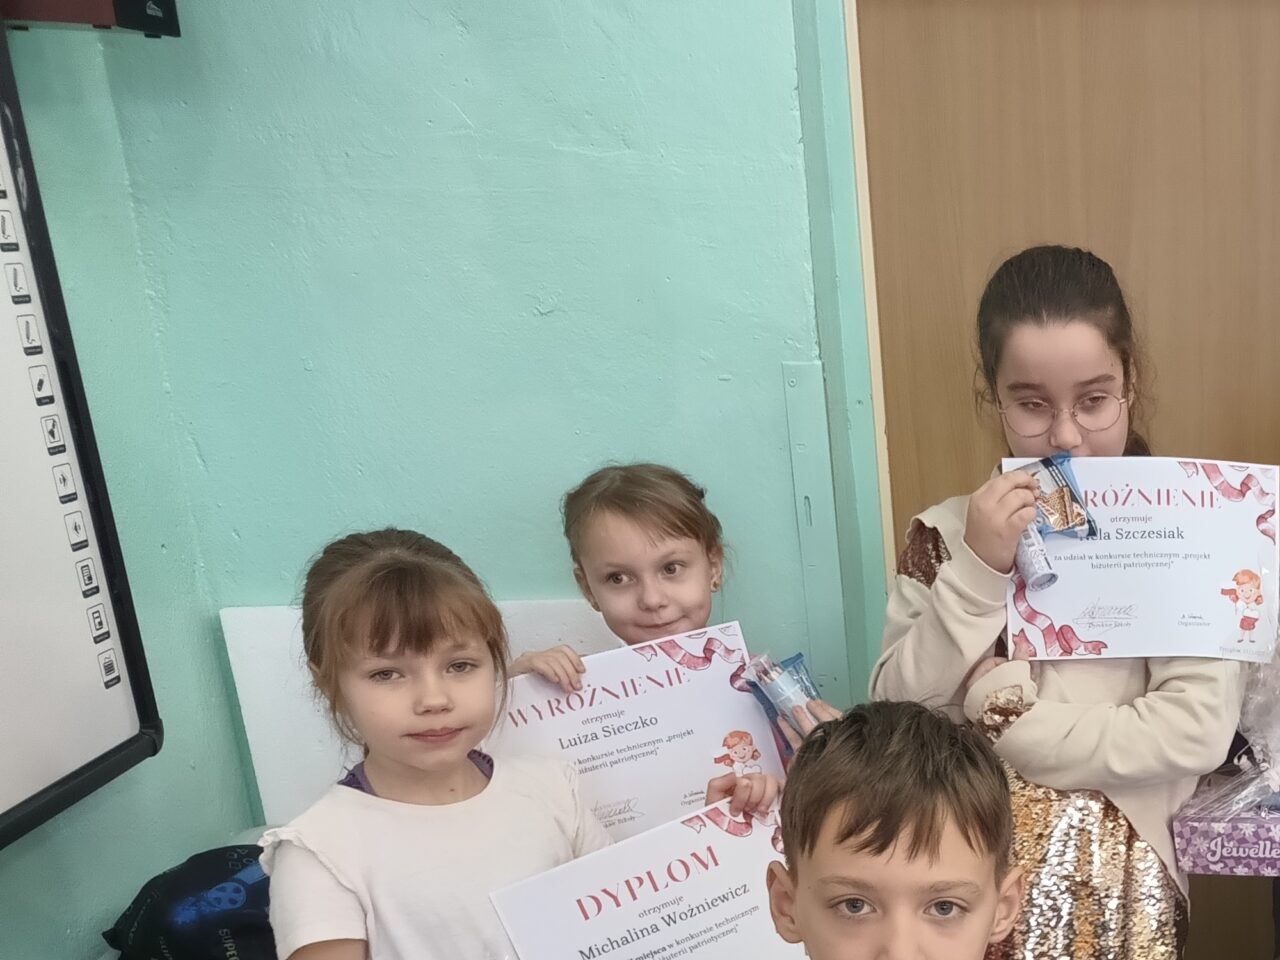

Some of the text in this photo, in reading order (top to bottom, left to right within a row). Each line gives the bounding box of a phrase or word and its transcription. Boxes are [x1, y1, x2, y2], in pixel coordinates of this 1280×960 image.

[1083, 483, 1223, 510] RÓŻNIENIE
[1110, 514, 1152, 524] otrzymuje
[1079, 526, 1185, 542] la Szczesiak
[1132, 552, 1180, 560] technicznym
[509, 666, 691, 729] WYRÓŻNIENIE
[581, 709, 625, 726] otrzymuje
[559, 714, 659, 750] Luiza Sieczko
[577, 749, 615, 765] konkursie
[615, 736, 664, 755] technicznym
[576, 845, 720, 921] DYPLOM
[638, 894, 685, 919] otrzymuje
[661, 883, 750, 928] Woźniewicz
[667, 943, 675, 952] w
[674, 922, 714, 947] konkursie
[713, 905, 760, 931] technicznym
